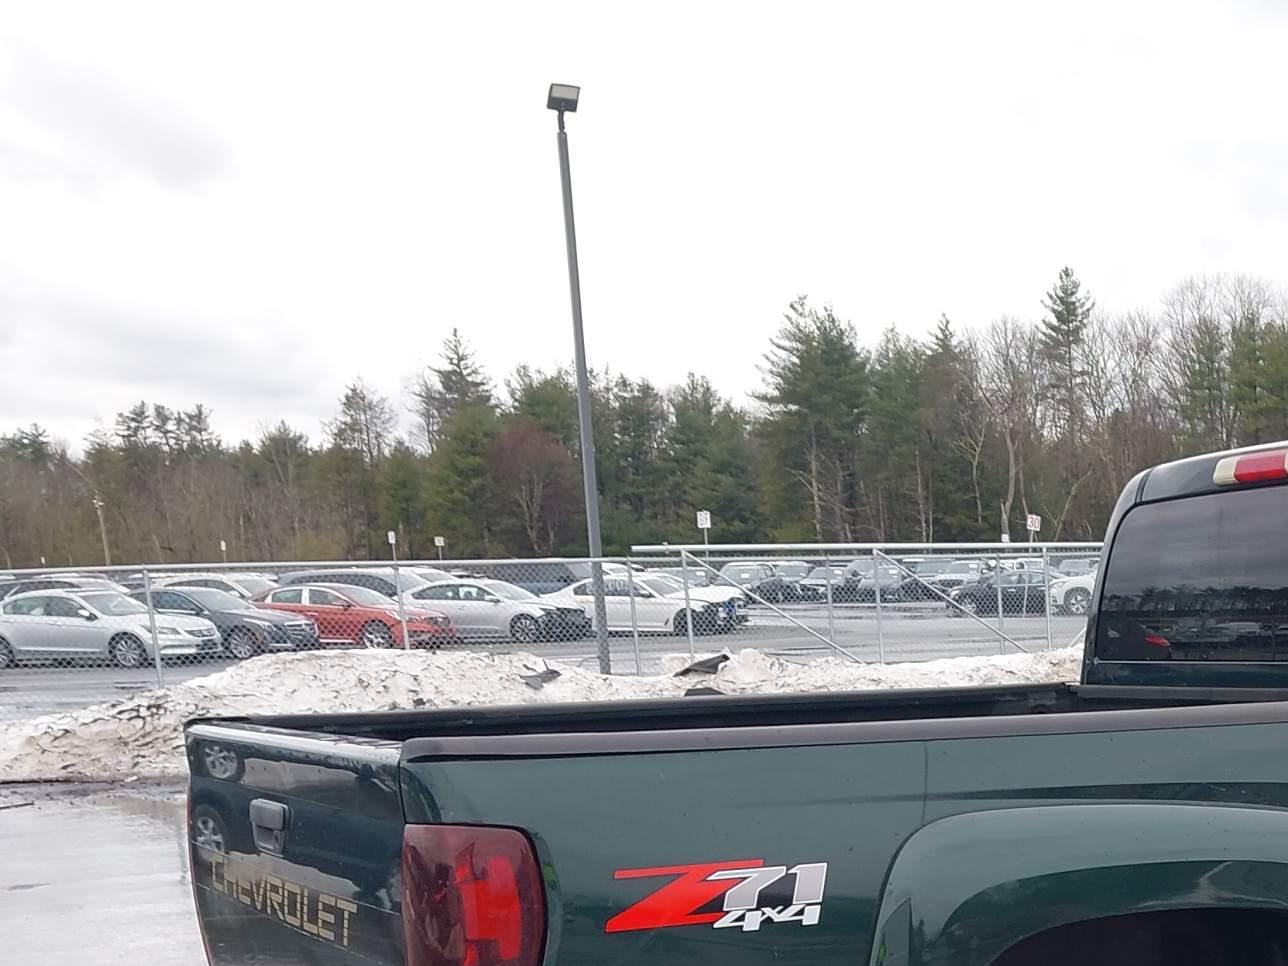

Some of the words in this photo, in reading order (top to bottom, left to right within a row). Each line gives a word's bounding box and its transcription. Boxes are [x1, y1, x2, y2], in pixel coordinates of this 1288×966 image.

[1029, 516, 1040, 529] 30
[212, 854, 357, 946] CHEVROLET
[605, 859, 828, 933] Z71
